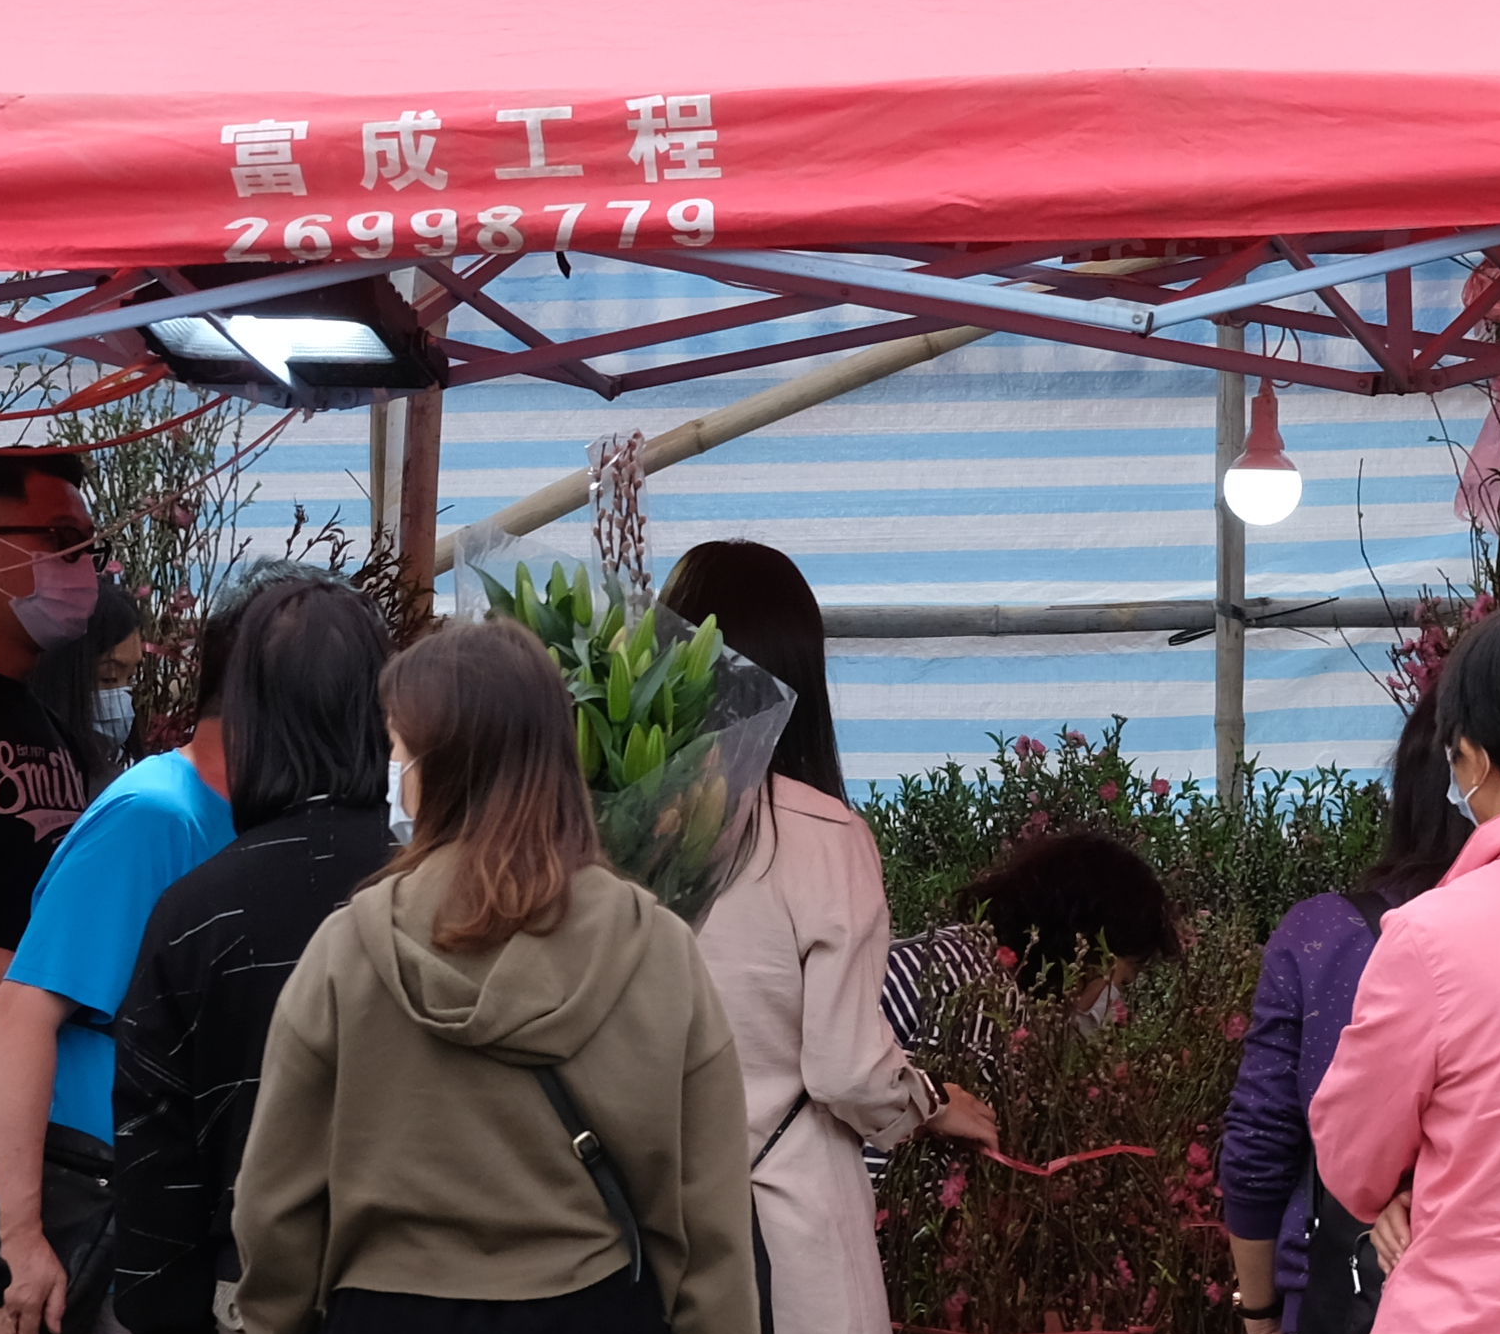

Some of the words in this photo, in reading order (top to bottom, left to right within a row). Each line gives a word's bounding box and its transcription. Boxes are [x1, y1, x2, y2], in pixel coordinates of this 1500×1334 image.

[220, 94, 722, 198] 富成工程
[222, 198, 716, 264] 26998779
